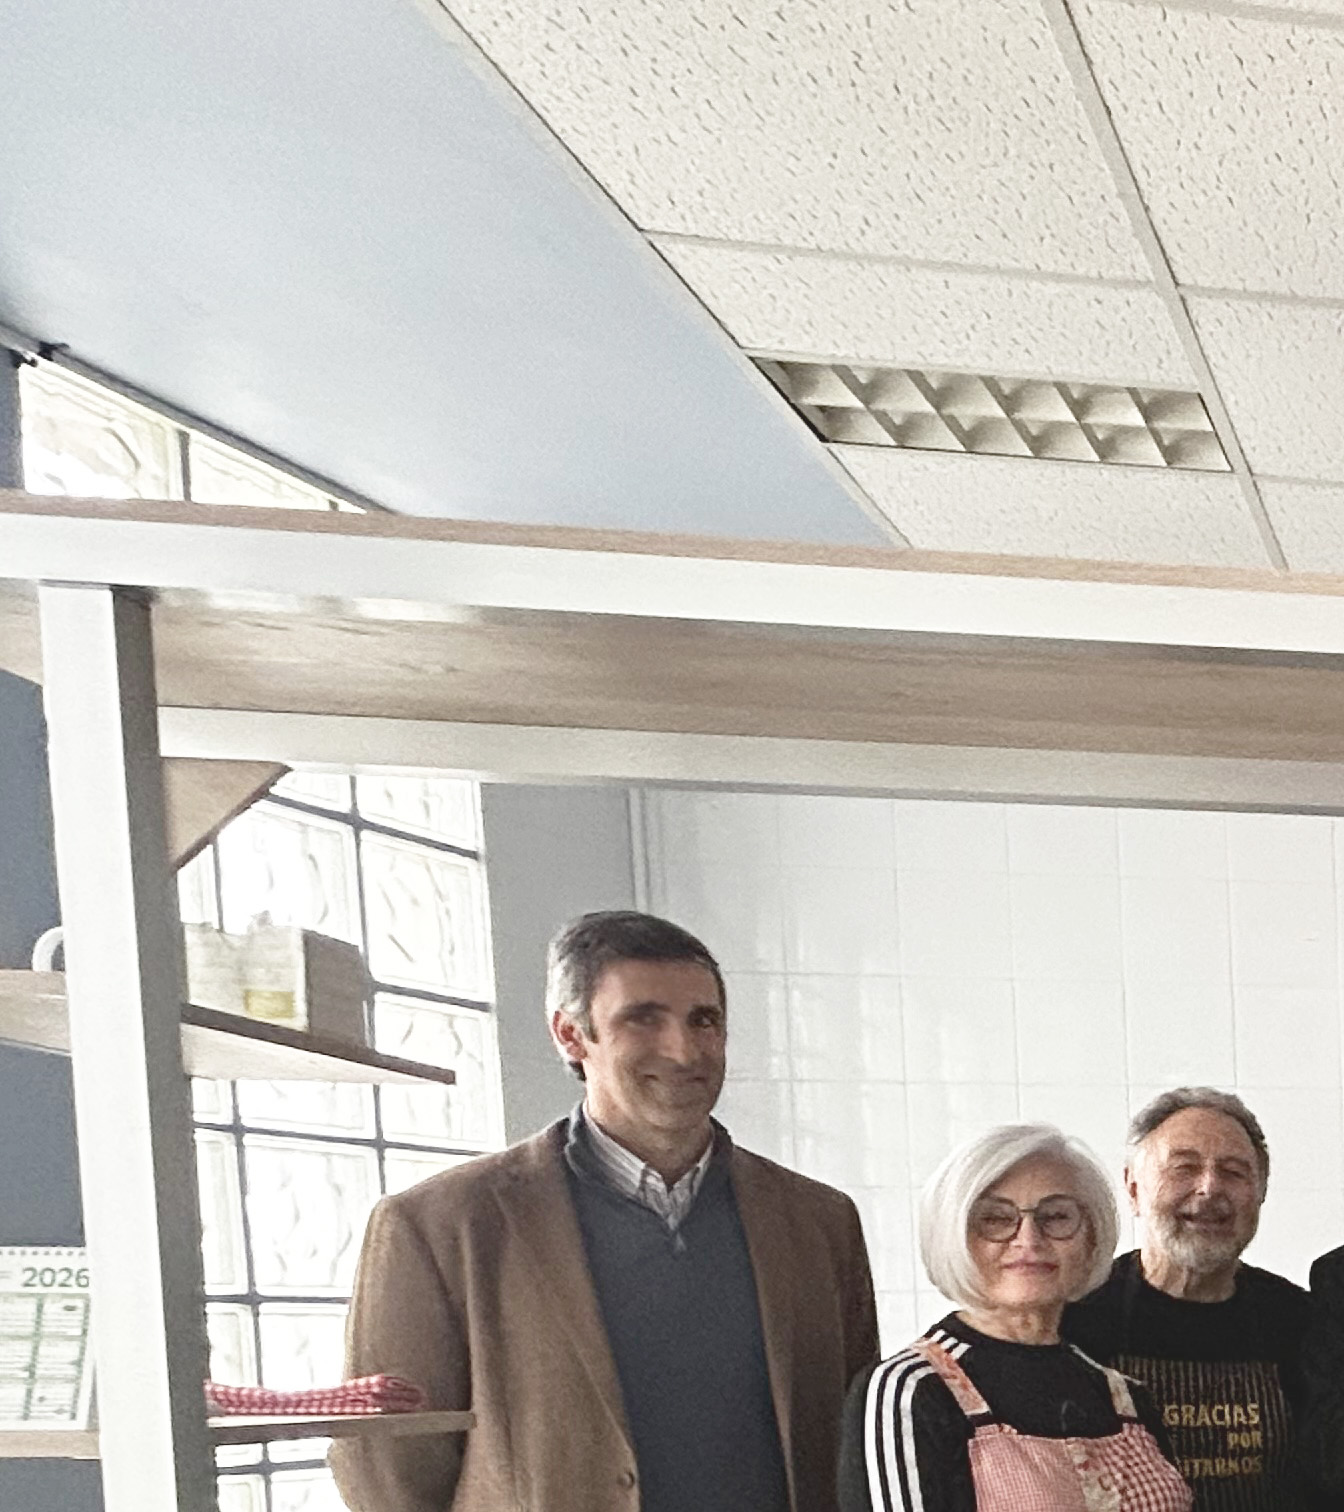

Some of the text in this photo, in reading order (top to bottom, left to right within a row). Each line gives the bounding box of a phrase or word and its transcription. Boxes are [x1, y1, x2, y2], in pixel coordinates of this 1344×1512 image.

[21, 1266, 90, 1288] 2026
[1163, 1403, 1260, 1427] GRACIAS
[1229, 1431, 1262, 1449] POR
